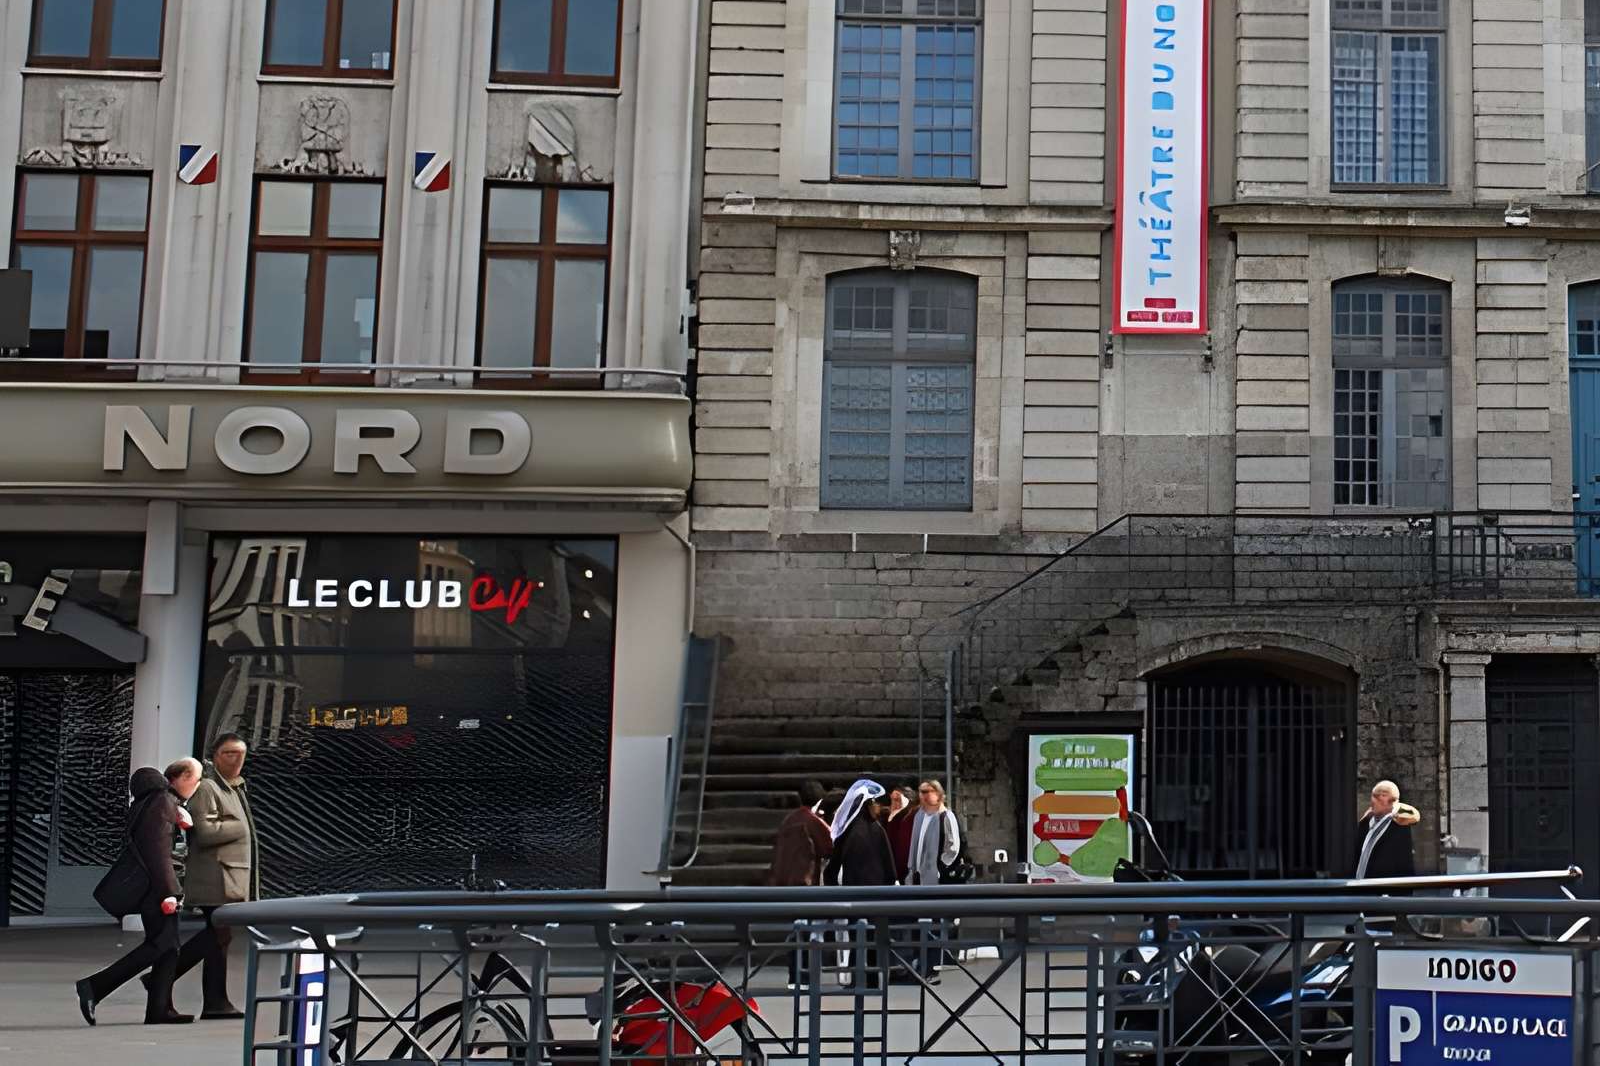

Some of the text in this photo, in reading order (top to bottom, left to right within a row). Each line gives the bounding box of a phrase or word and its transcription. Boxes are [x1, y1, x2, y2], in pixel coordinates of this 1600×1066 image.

[1152, 63, 1175, 111] DU
[1138, 125, 1175, 287] THÉÂTRE
[103, 405, 533, 475] NORD
[1389, 1005, 1422, 1063] P
